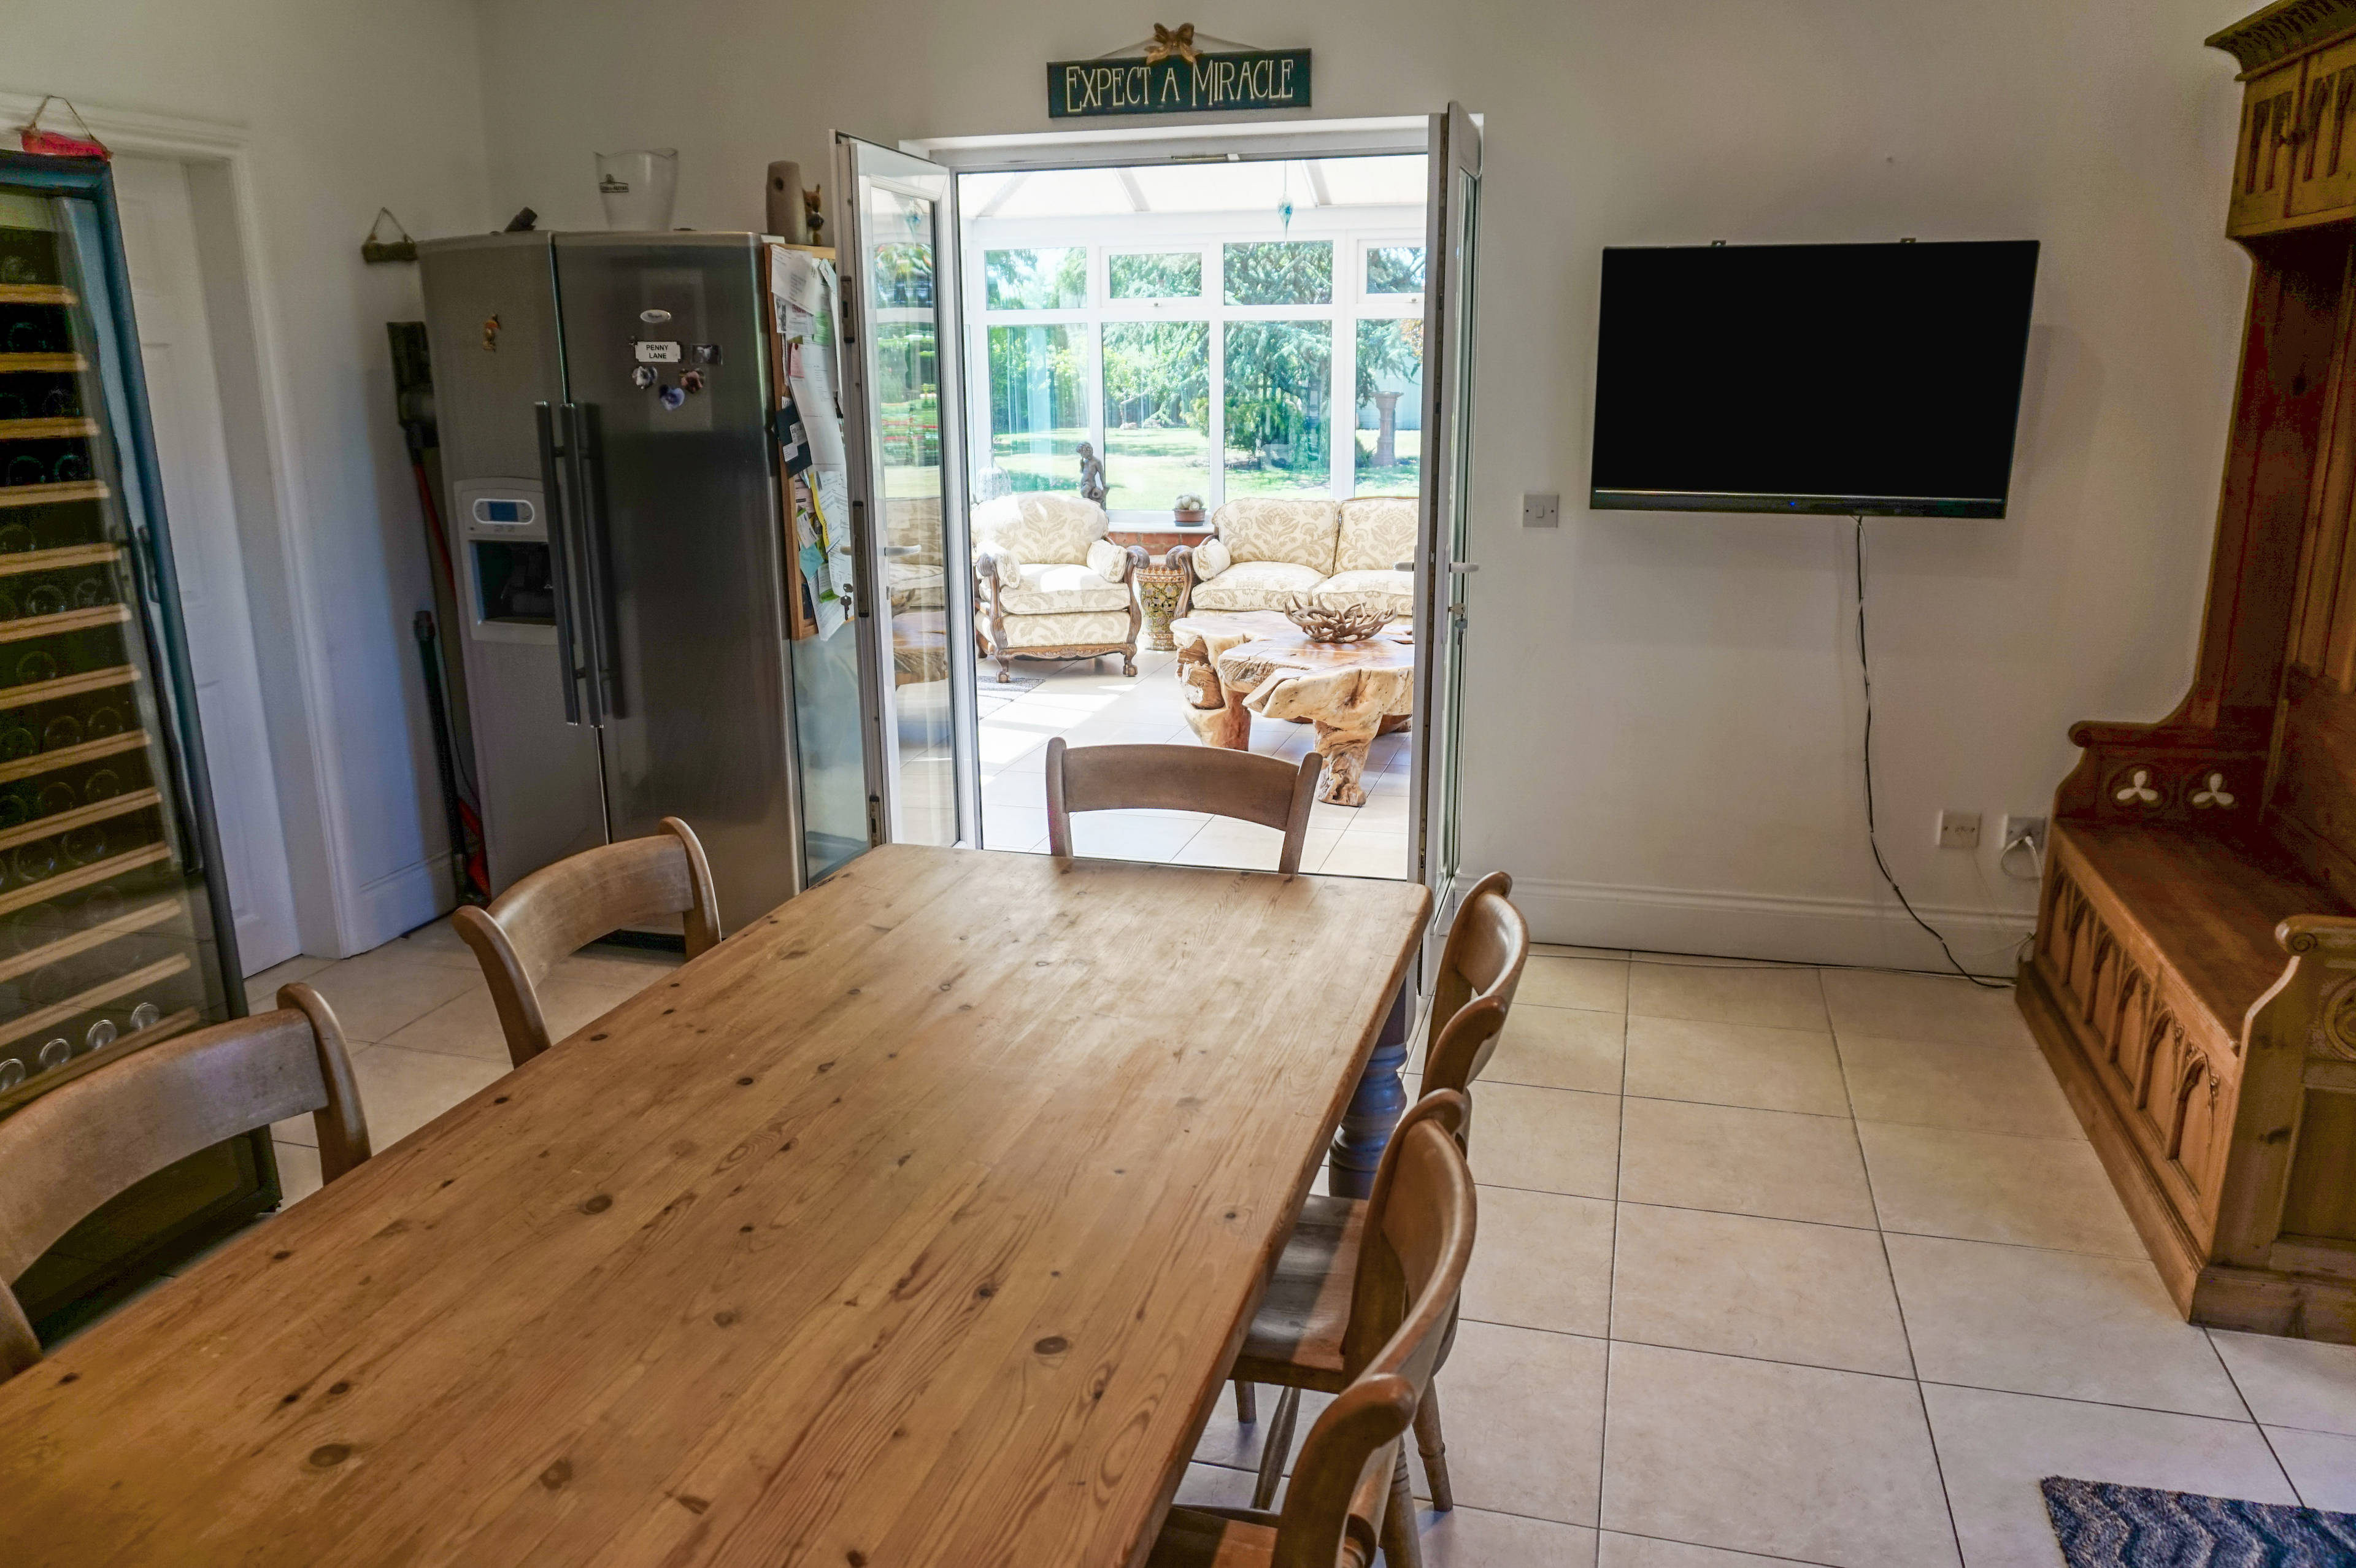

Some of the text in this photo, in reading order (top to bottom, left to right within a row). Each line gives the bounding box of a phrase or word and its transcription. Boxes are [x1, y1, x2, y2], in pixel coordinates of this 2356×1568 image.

[1066, 59, 1293, 112] EXPECT A MIRACLE
